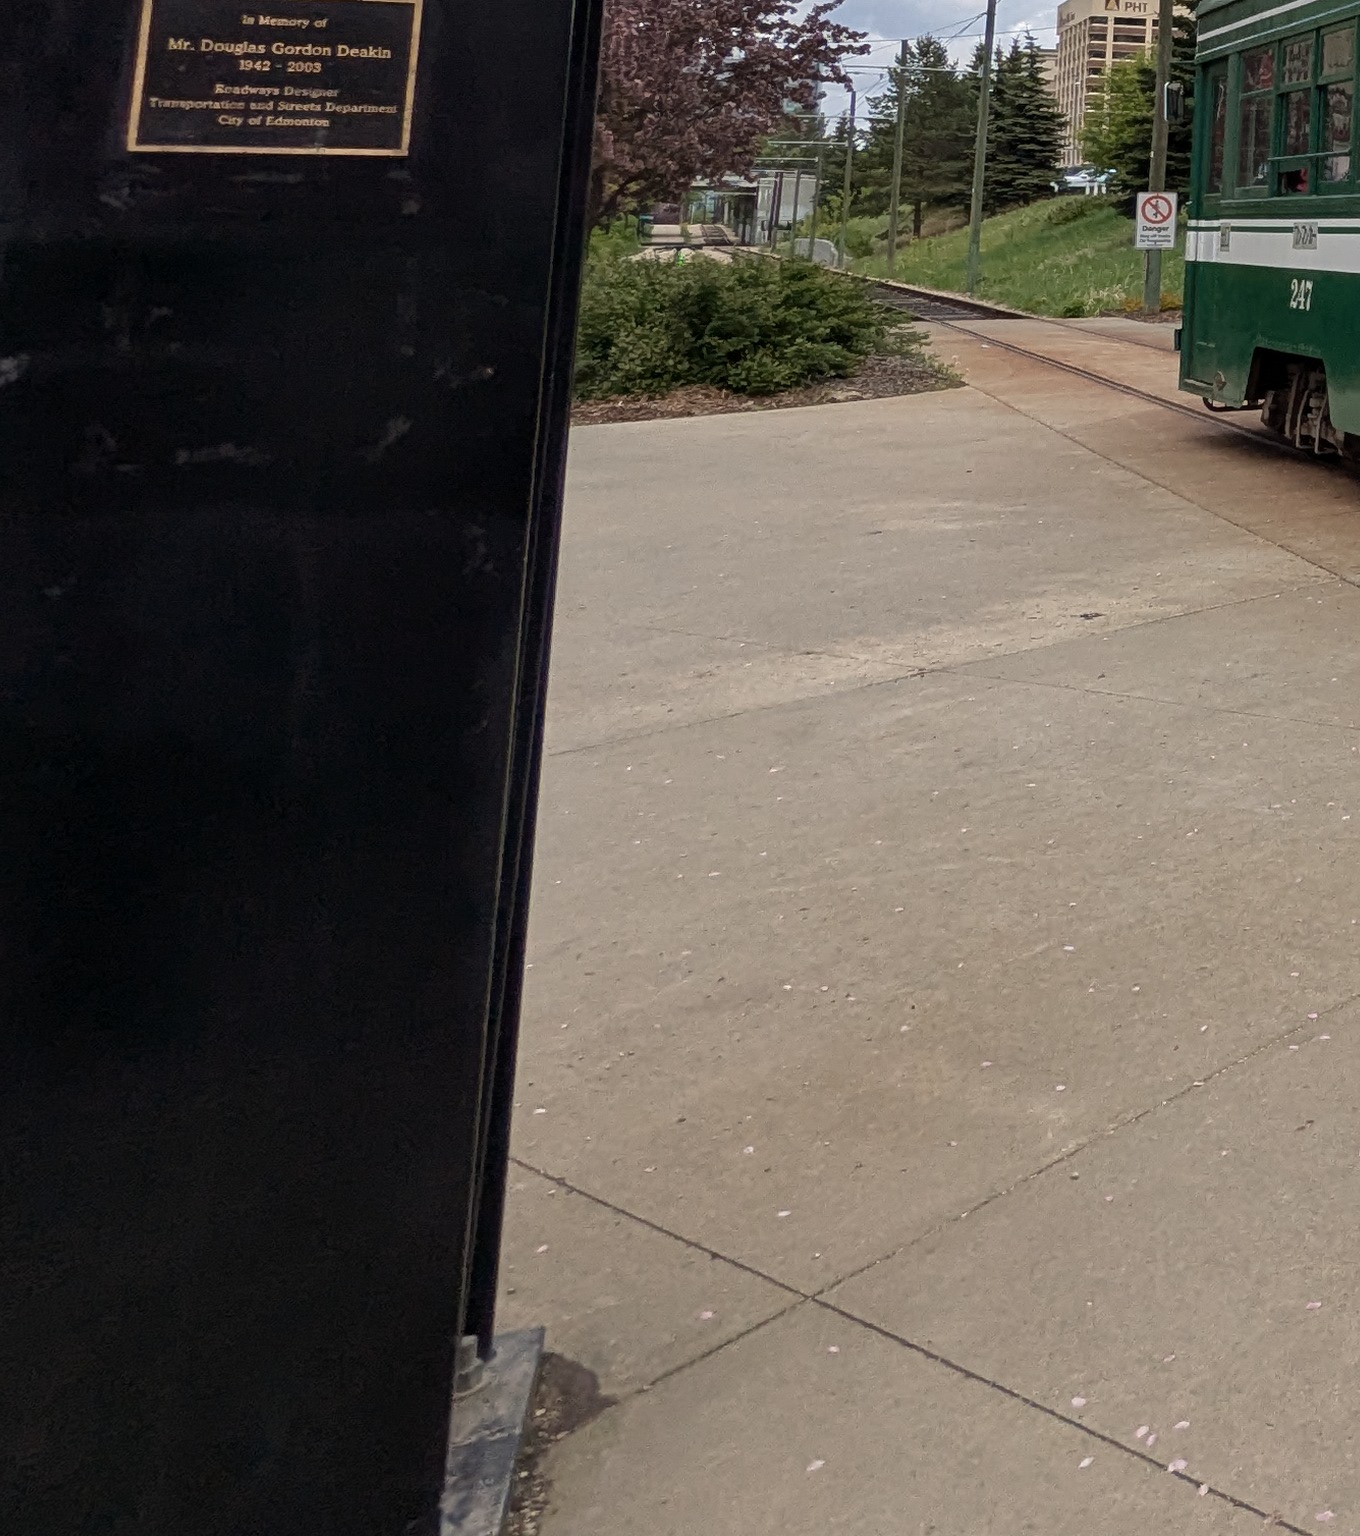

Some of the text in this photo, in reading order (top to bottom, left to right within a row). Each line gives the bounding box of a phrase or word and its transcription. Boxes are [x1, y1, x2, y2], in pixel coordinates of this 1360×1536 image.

[258, 15, 309, 29] Memory
[314, 17, 329, 29] of
[167, 37, 391, 59] Mr. Douglas Gordon Deakin
[239, 59, 271, 72] 1942
[214, 83, 339, 99] Roadways Designer
[150, 97, 397, 114] Transportation and Streets Department
[217, 115, 330, 128] City of Edmonton
[1142, 225, 1169, 233] Danger
[1289, 278, 1313, 311] 247
